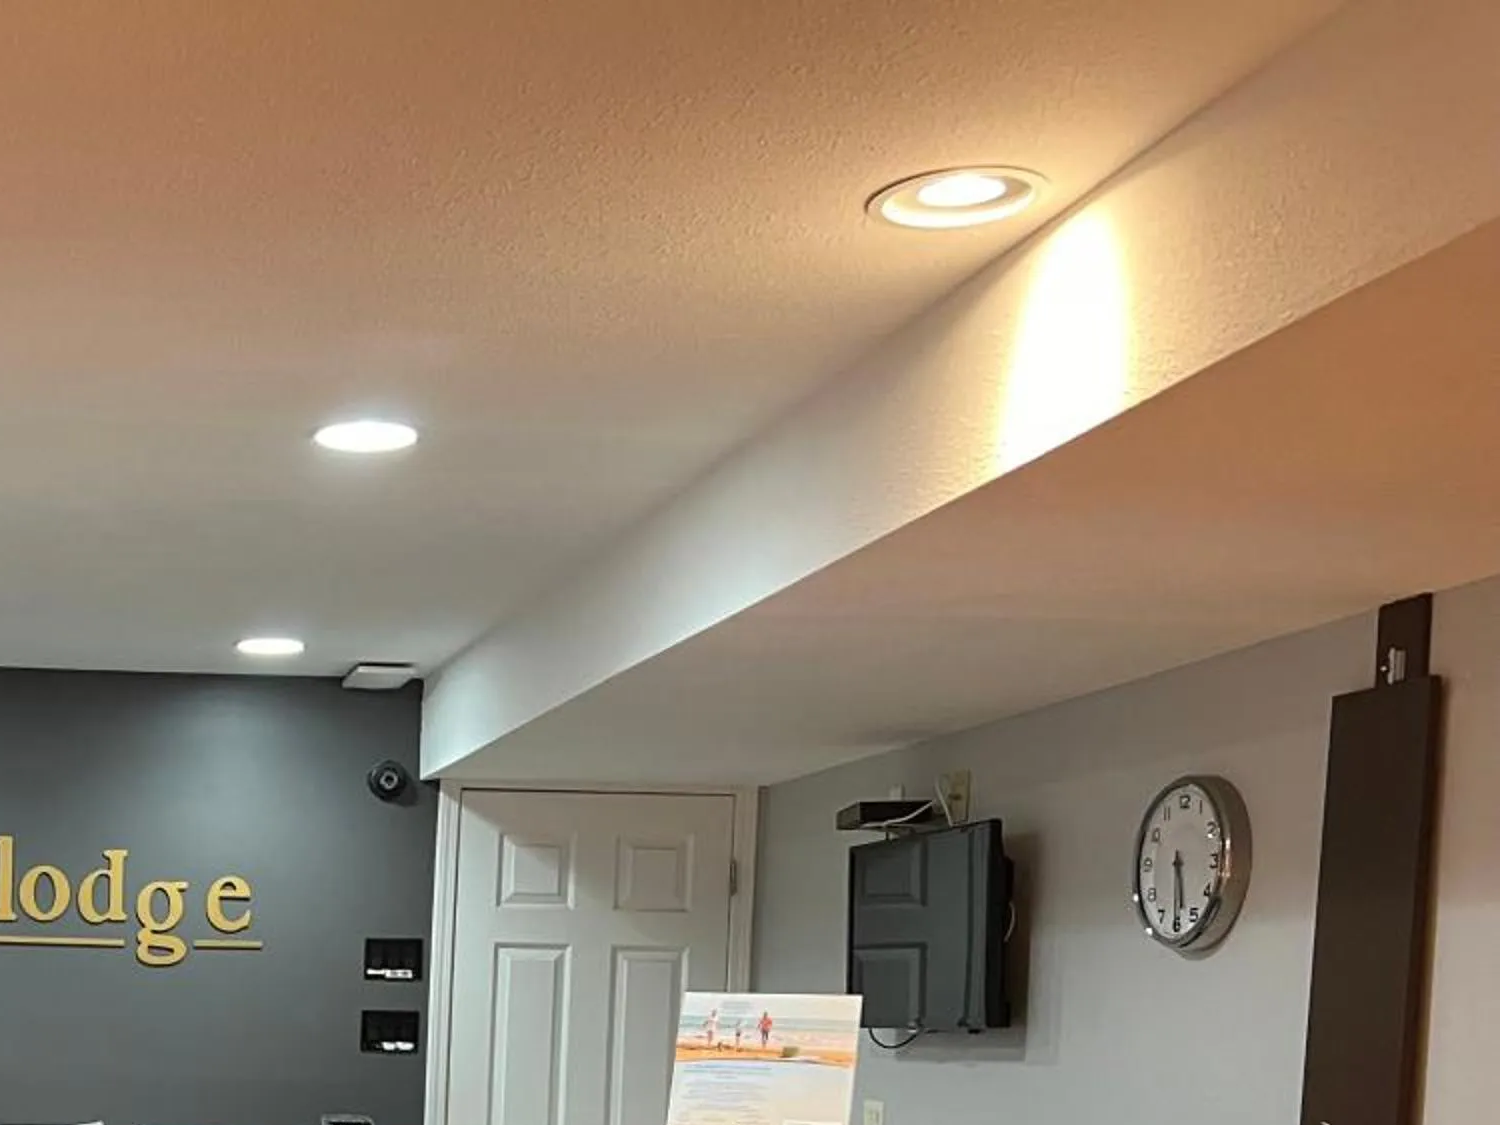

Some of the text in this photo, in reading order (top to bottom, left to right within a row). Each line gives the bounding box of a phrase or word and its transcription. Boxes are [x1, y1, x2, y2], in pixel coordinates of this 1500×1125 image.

[1180, 795, 1191, 809] 12
[1164, 806, 1171, 821] 11
[1144, 857, 1153, 872] 9
[1210, 854, 1219, 869] 3
[1148, 888, 1157, 902] 8
[1158, 909, 1166, 924] 7
[1190, 907, 1199, 922] 5
[1172, 918, 1181, 933] 6
